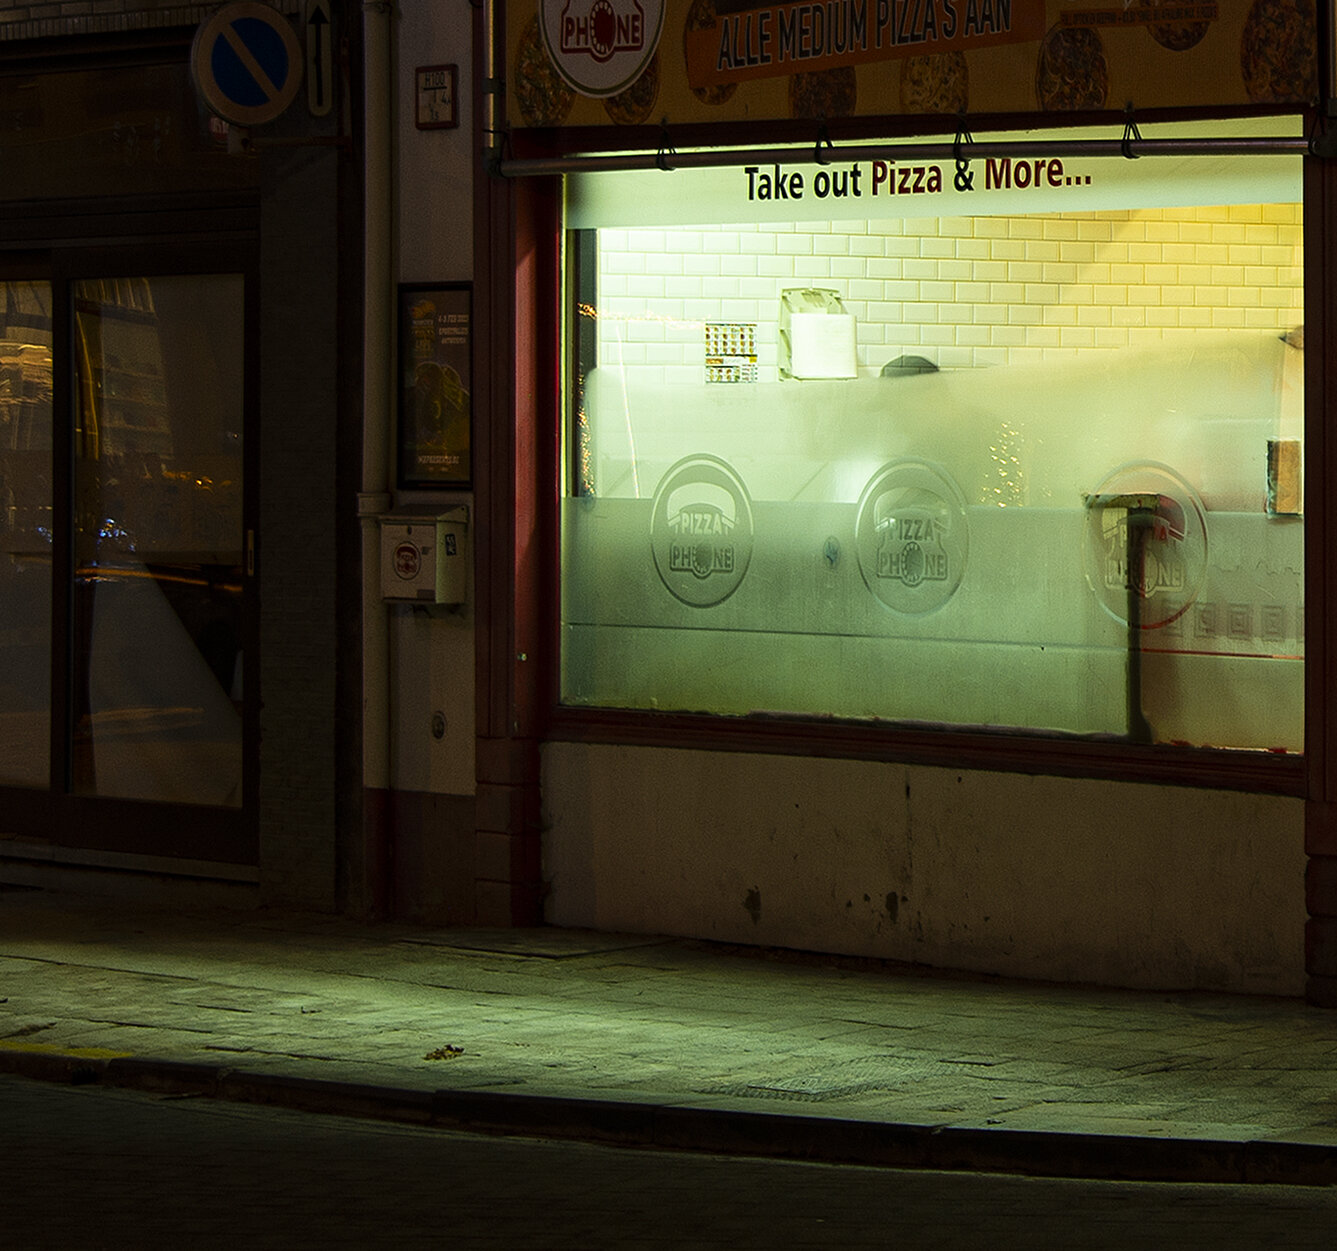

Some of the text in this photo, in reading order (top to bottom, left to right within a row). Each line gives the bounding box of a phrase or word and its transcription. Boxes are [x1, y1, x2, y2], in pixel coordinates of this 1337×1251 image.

[565, 4, 641, 53] PHONE
[715, 0, 1012, 71] ALLE MEDIUM PIZZA'S AAN
[744, 157, 1093, 201] Take out Pizza & More...
[680, 511, 724, 535] PIZZA
[889, 518, 935, 542] PIZZA
[672, 545, 733, 573] PHONE
[880, 547, 946, 581] PHONE
